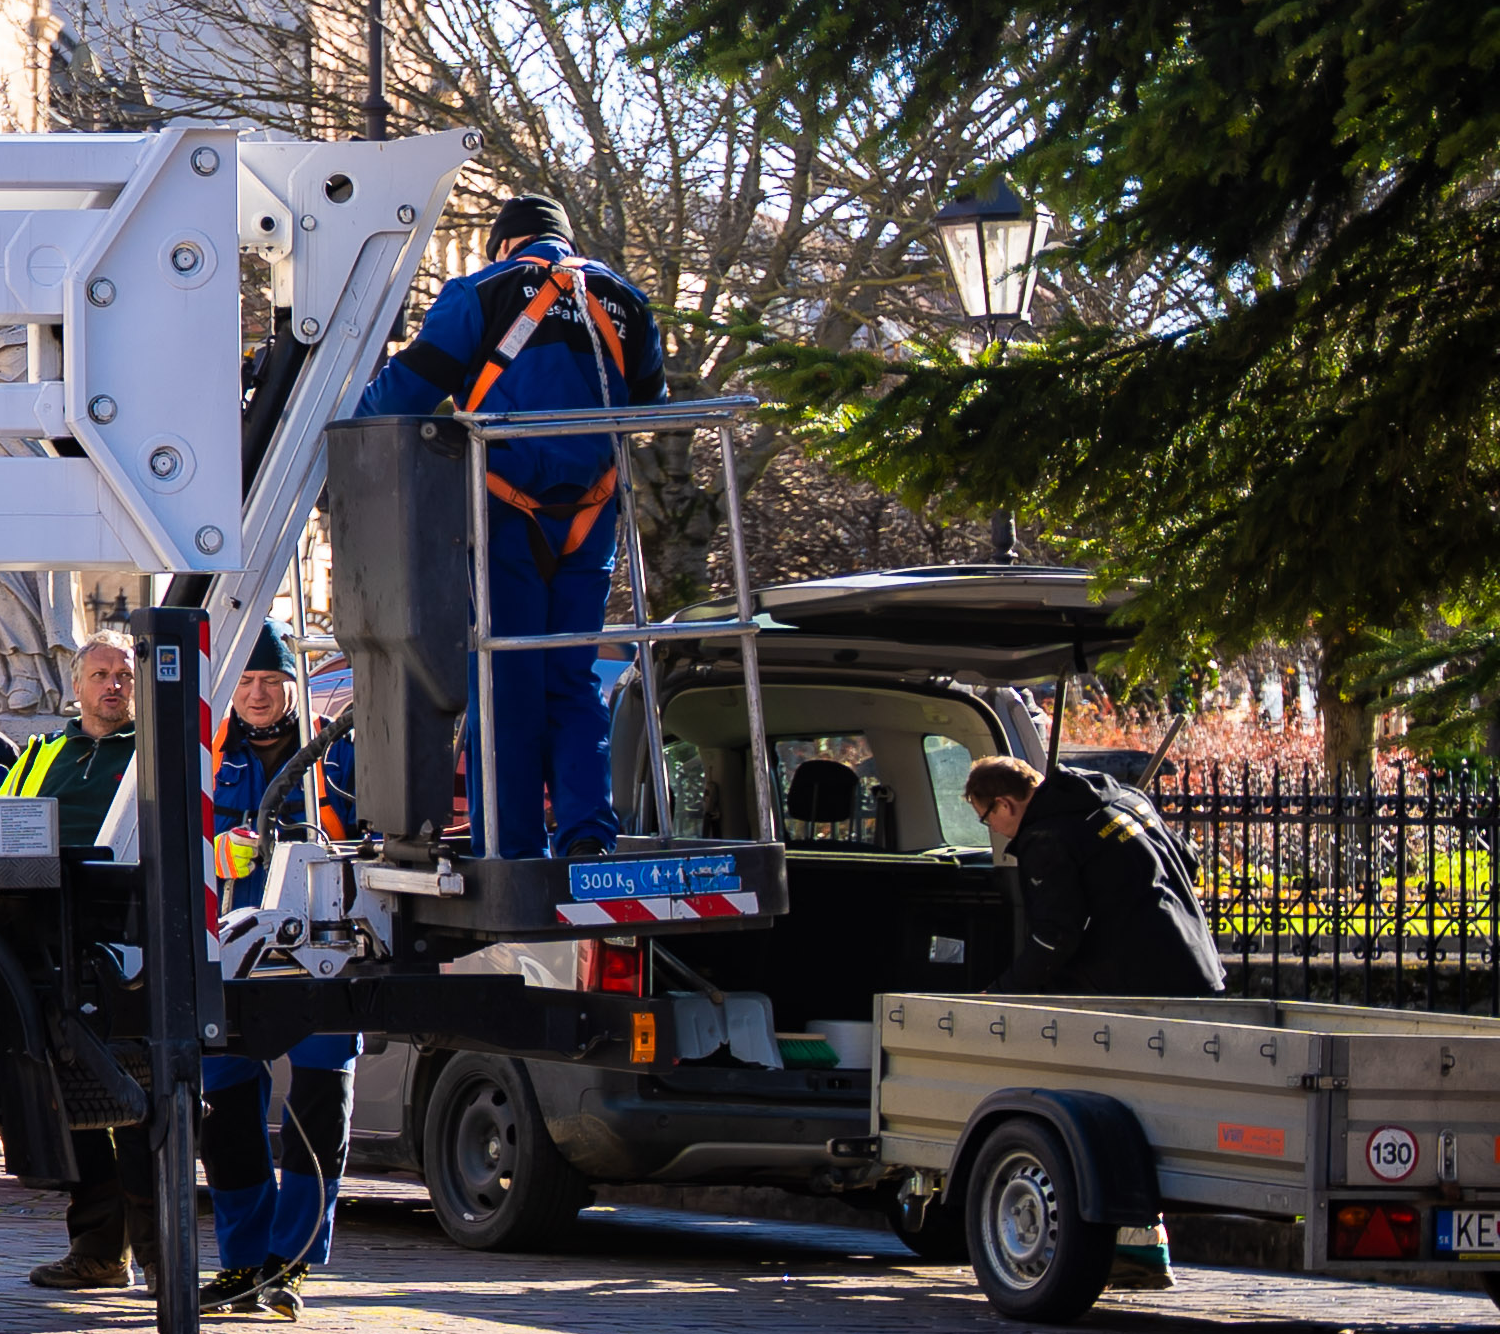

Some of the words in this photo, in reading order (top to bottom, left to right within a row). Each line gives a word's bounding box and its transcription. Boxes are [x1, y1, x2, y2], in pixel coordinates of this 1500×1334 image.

[580, 872, 613, 890] 300
[1372, 1141, 1412, 1166] 130
[1456, 1212, 1495, 1248] KE
